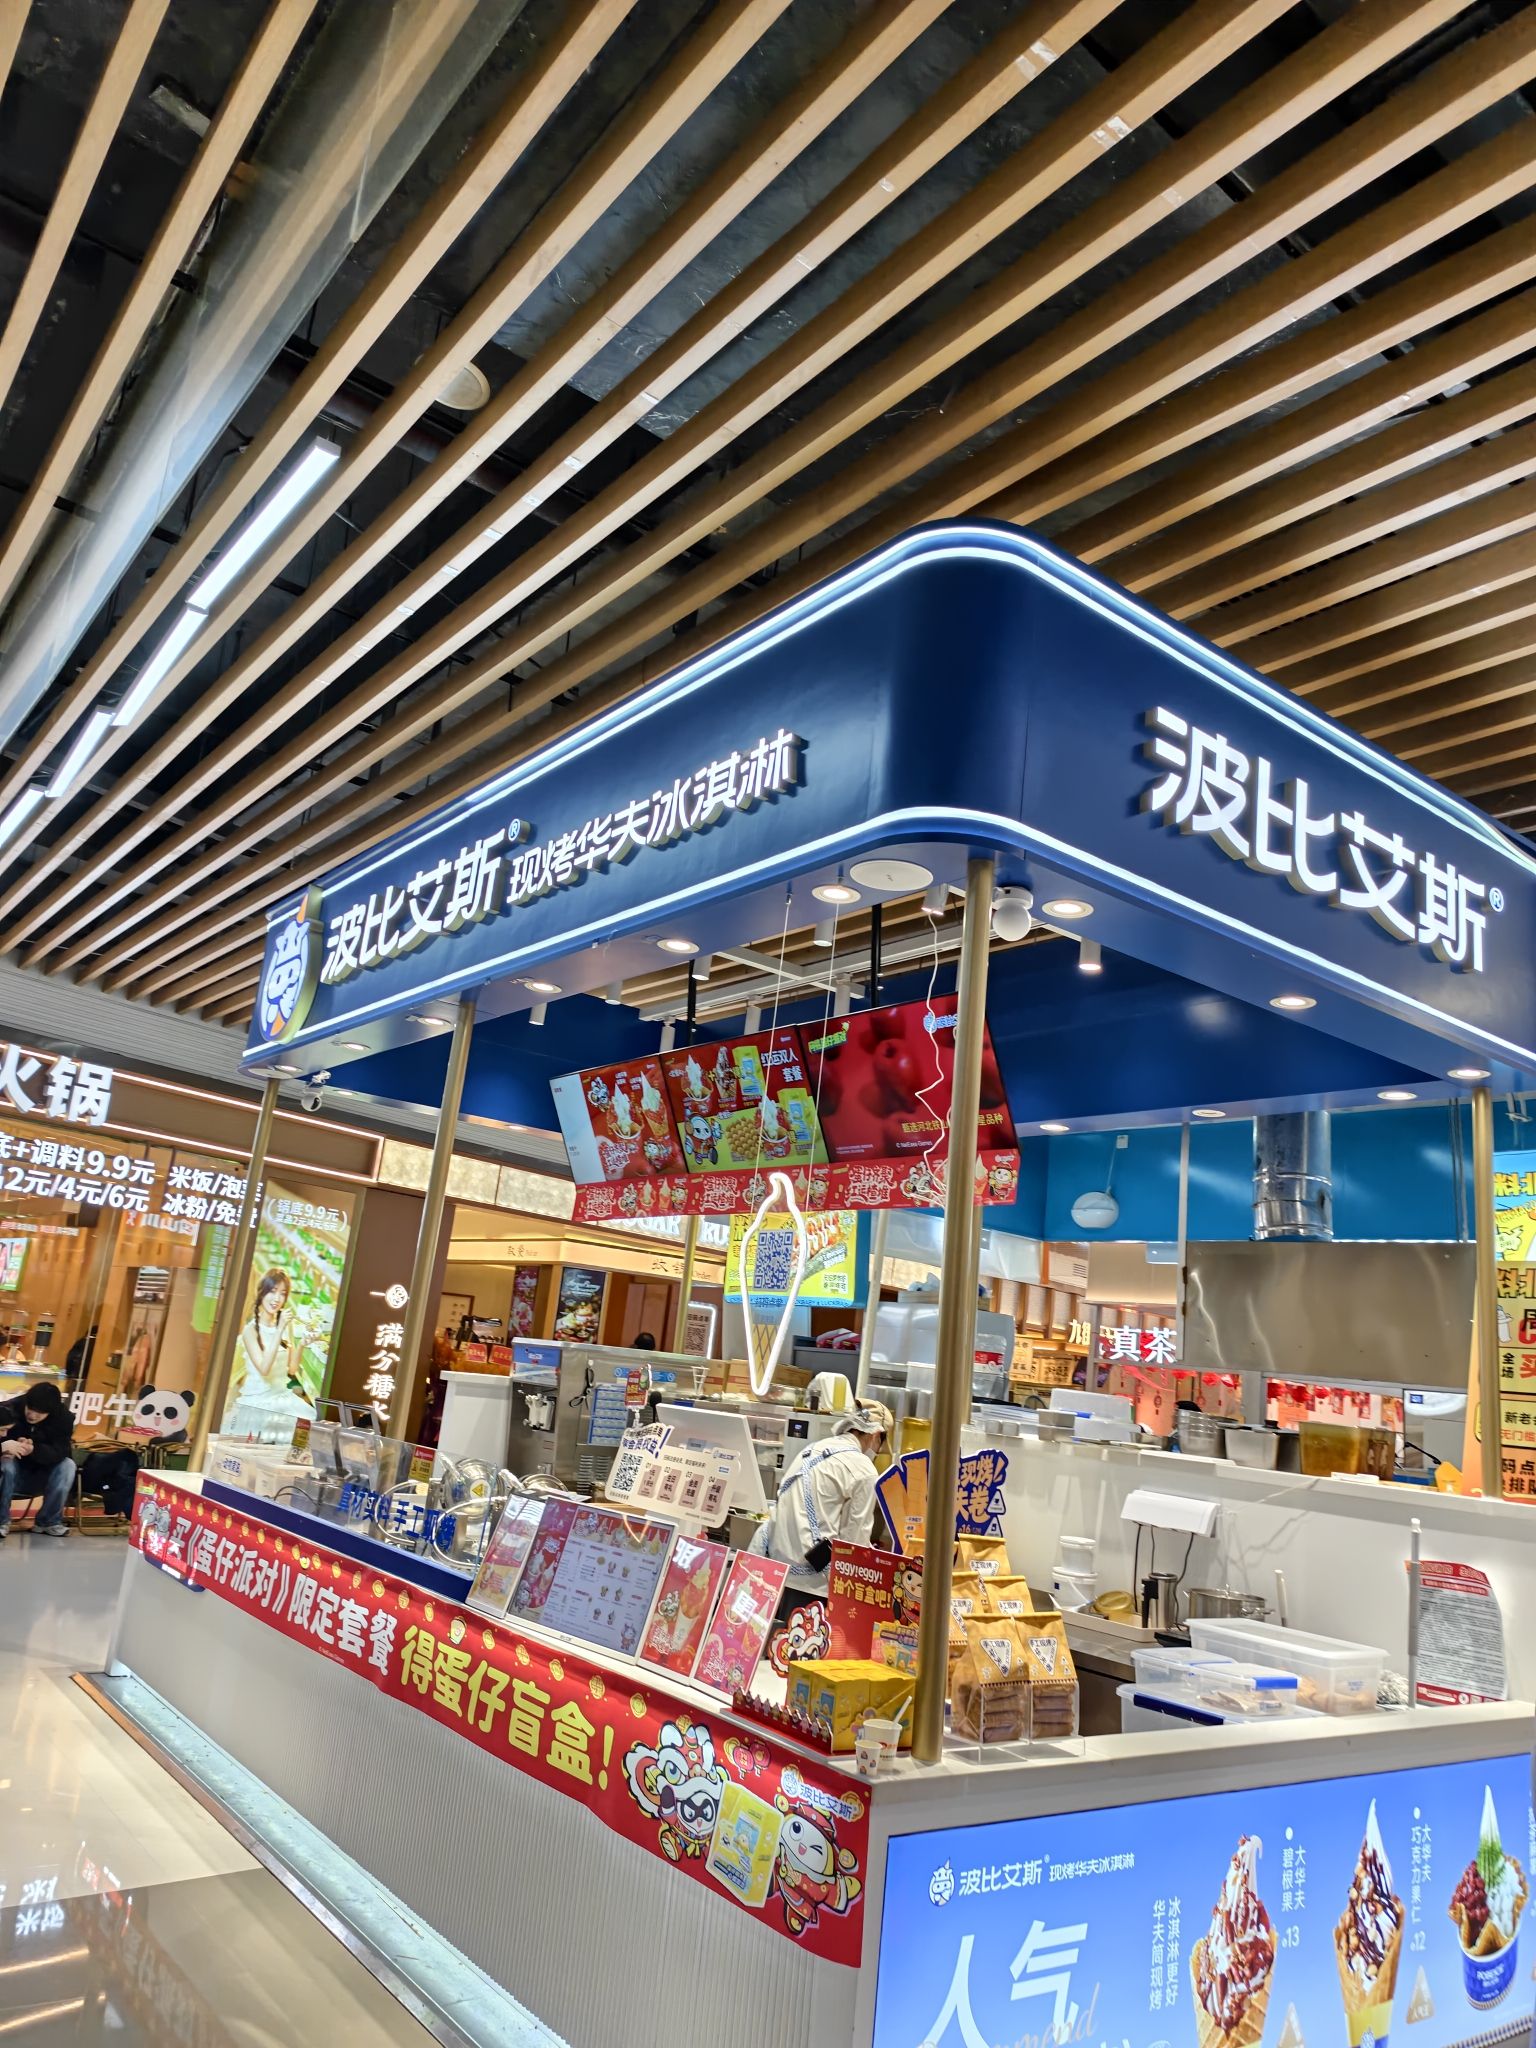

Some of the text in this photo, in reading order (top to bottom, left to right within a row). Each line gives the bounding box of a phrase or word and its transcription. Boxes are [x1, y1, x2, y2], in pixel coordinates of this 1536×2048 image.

[321, 729, 795, 983] 波比艾斯 现烤华夫冰淇淋
[1152, 707, 1486, 971] 波比艾斯
[0, 1044, 113, 1126] 火锅
[0, 1164, 150, 1212] 2元/4元/6元
[361, 1322, 405, 1421] 满分糖水
[832, 1576, 892, 1609] 抽个盲盒吧!
[168, 1516, 398, 1677] 买《蛋仔派对》限定套餐
[400, 1625, 617, 1792] 得蛋仔盲盒!
[799, 1782, 853, 1819] 波比艾斯
[958, 1852, 1136, 1896] 波比艾斯 现烤华夫冰淇淋
[1281, 1847, 1294, 1912] 碧根果
[1294, 1845, 1306, 1910] 大华夫
[1411, 1826, 1422, 1925] 巧克力果仁
[1421, 1824, 1432, 1882] 大华夫
[914, 1919, 1089, 2048] 人气
[1149, 1899, 1166, 2010] 华夫筒现烤
[1165, 1896, 1181, 2007] 冰淇淋更好
